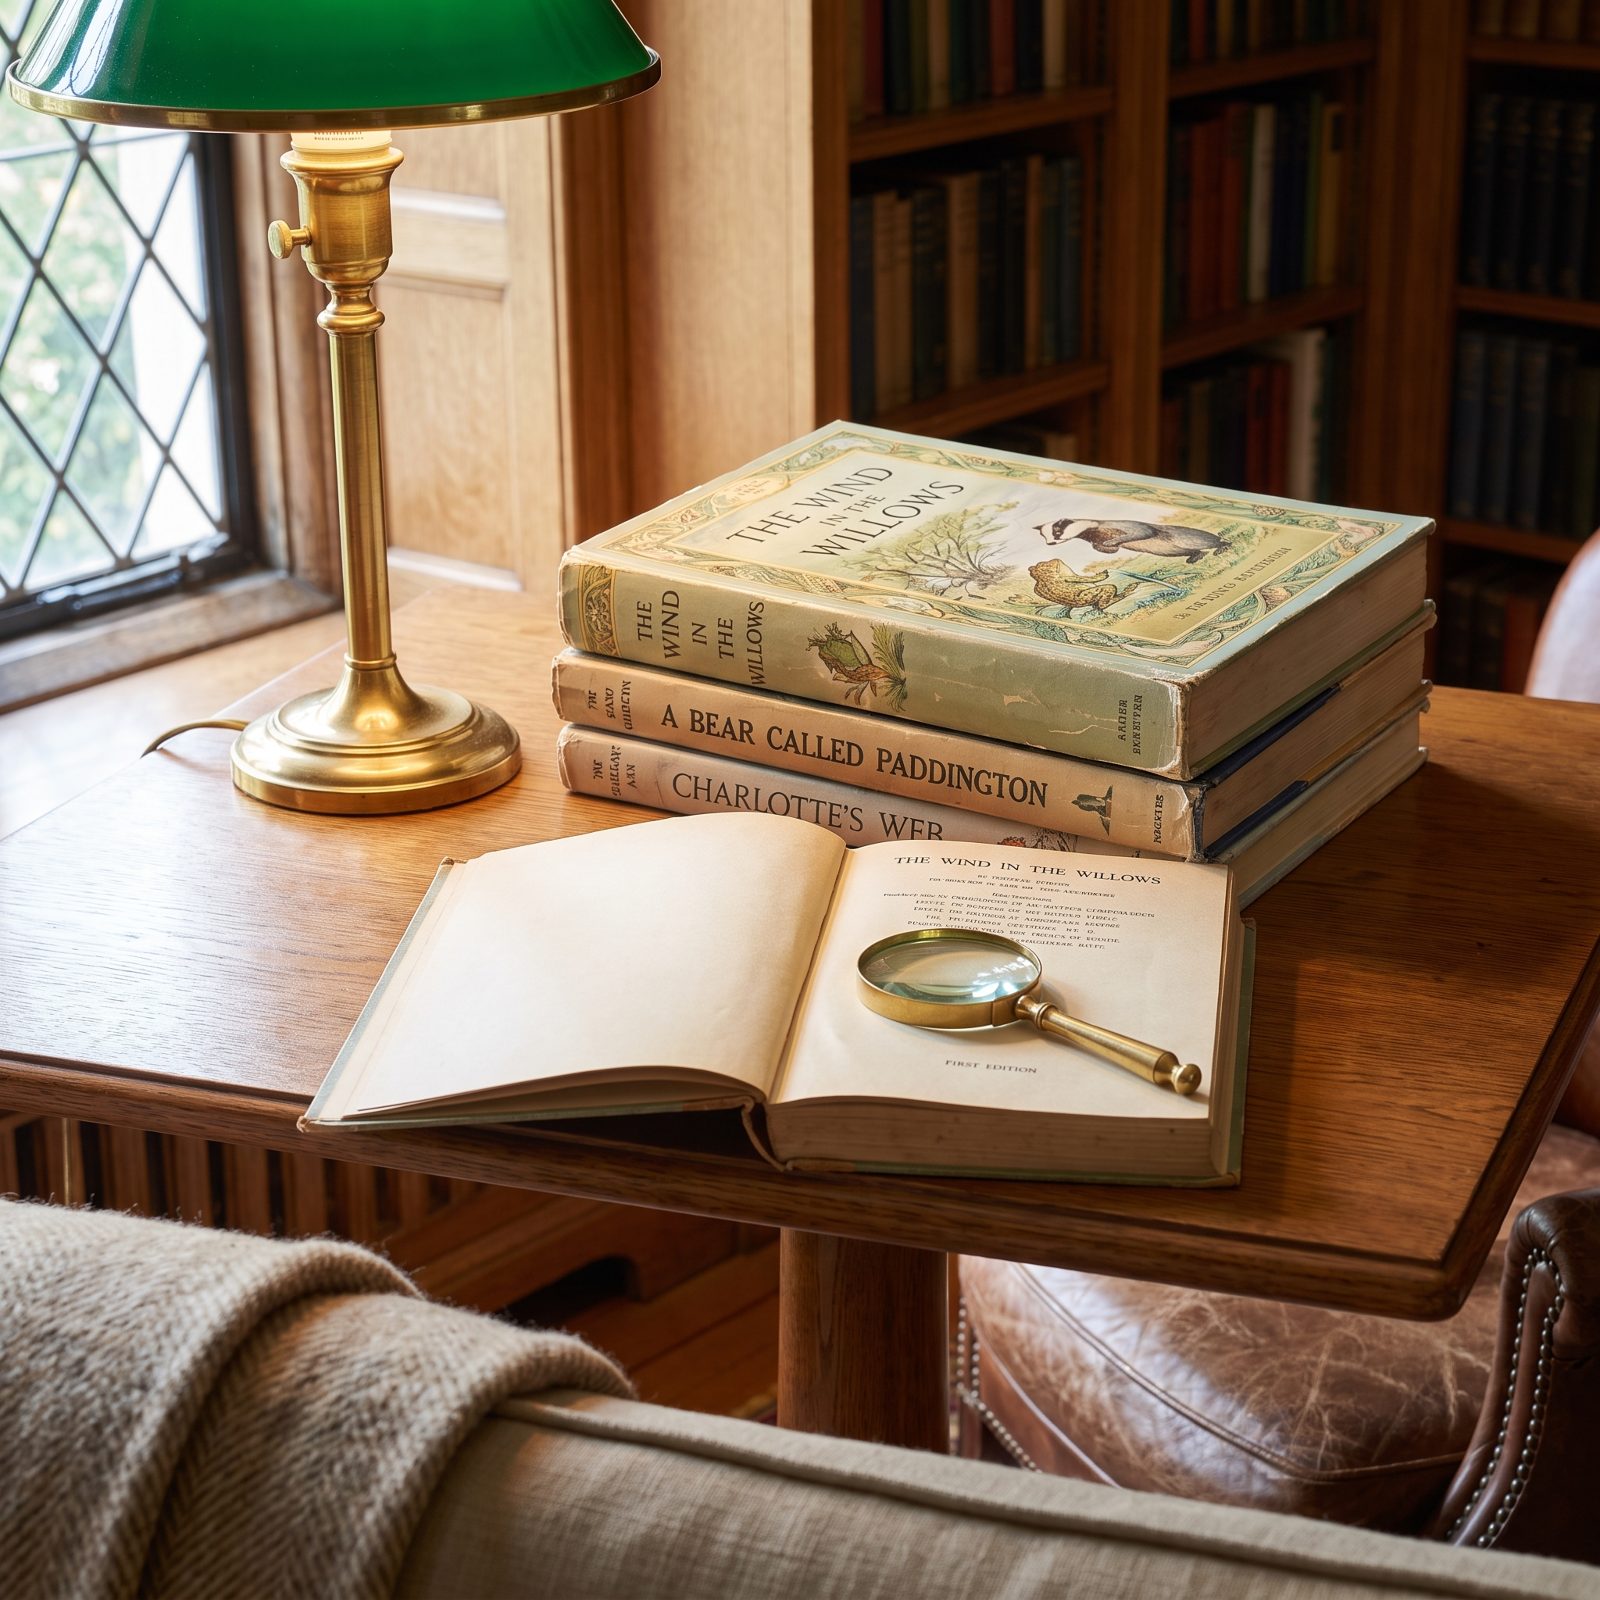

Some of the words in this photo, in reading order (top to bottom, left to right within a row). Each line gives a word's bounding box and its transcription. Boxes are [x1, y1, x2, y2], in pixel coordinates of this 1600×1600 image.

[726, 510, 810, 543] THE
[792, 467, 893, 508] WIND
[799, 481, 964, 556] WILLOWS
[819, 513, 847, 527] IN
[844, 494, 886, 513] THE
[637, 601, 653, 641] THE
[662, 590, 681, 658] WIND
[691, 622, 707, 646] IN
[717, 617, 734, 659] THE
[746, 601, 767, 685] WILLOWS
[660, 704, 678, 728] A
[689, 709, 755, 745] BEAR
[766, 726, 864, 767] CALLED
[876, 748, 1048, 808] PADDINGTON
[672, 773, 863, 832] CHARLOTTE'S
[894, 856, 930, 864] THE
[941, 858, 991, 868] WIND
[1000, 862, 1020, 871] IN
[1030, 865, 1066, 876] THE
[1076, 870, 1161, 885] WILLOWS
[945, 1059, 980, 1068] FIRST
[985, 1063, 1037, 1073] EDITION
